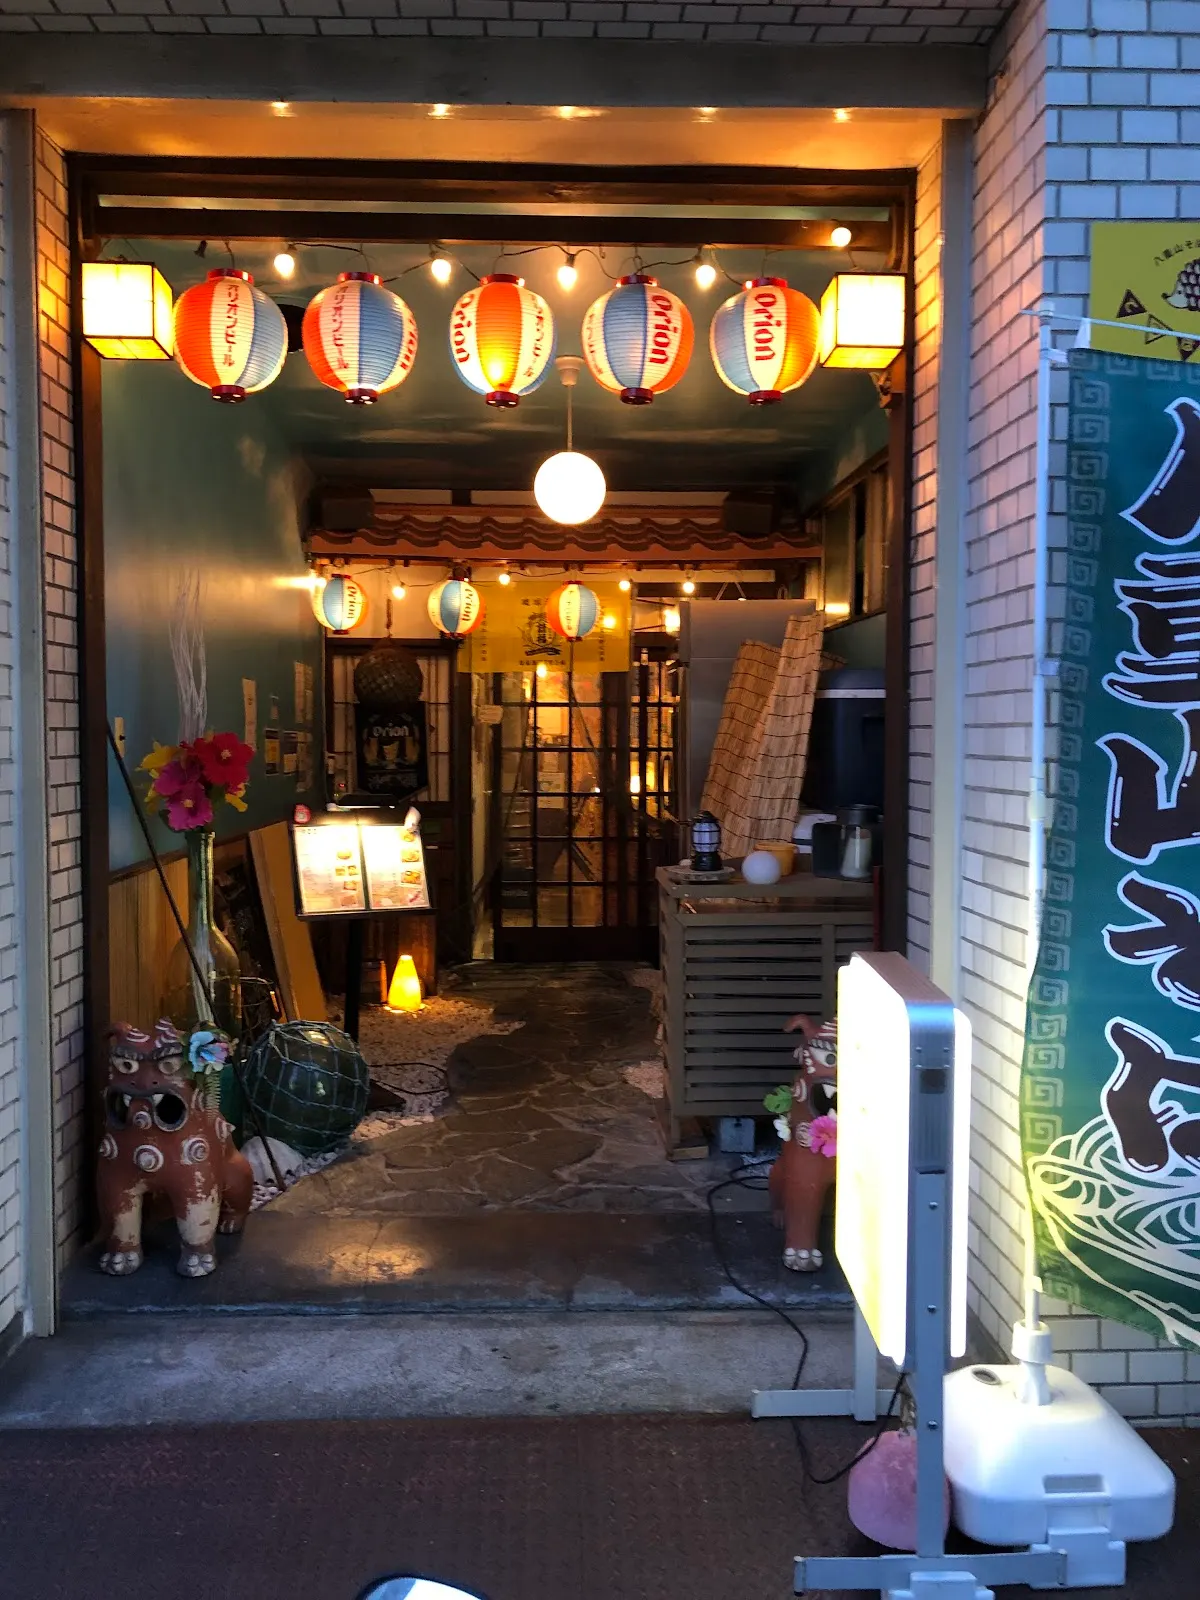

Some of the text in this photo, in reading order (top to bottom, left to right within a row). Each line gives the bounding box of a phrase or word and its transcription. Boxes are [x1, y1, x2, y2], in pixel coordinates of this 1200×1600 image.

[223, 284, 239, 367] オリオンビール
[331, 284, 349, 370] オリオンビール
[453, 293, 475, 363] Orion
[649, 295, 679, 365] Orion
[754, 293, 783, 361] Orion
